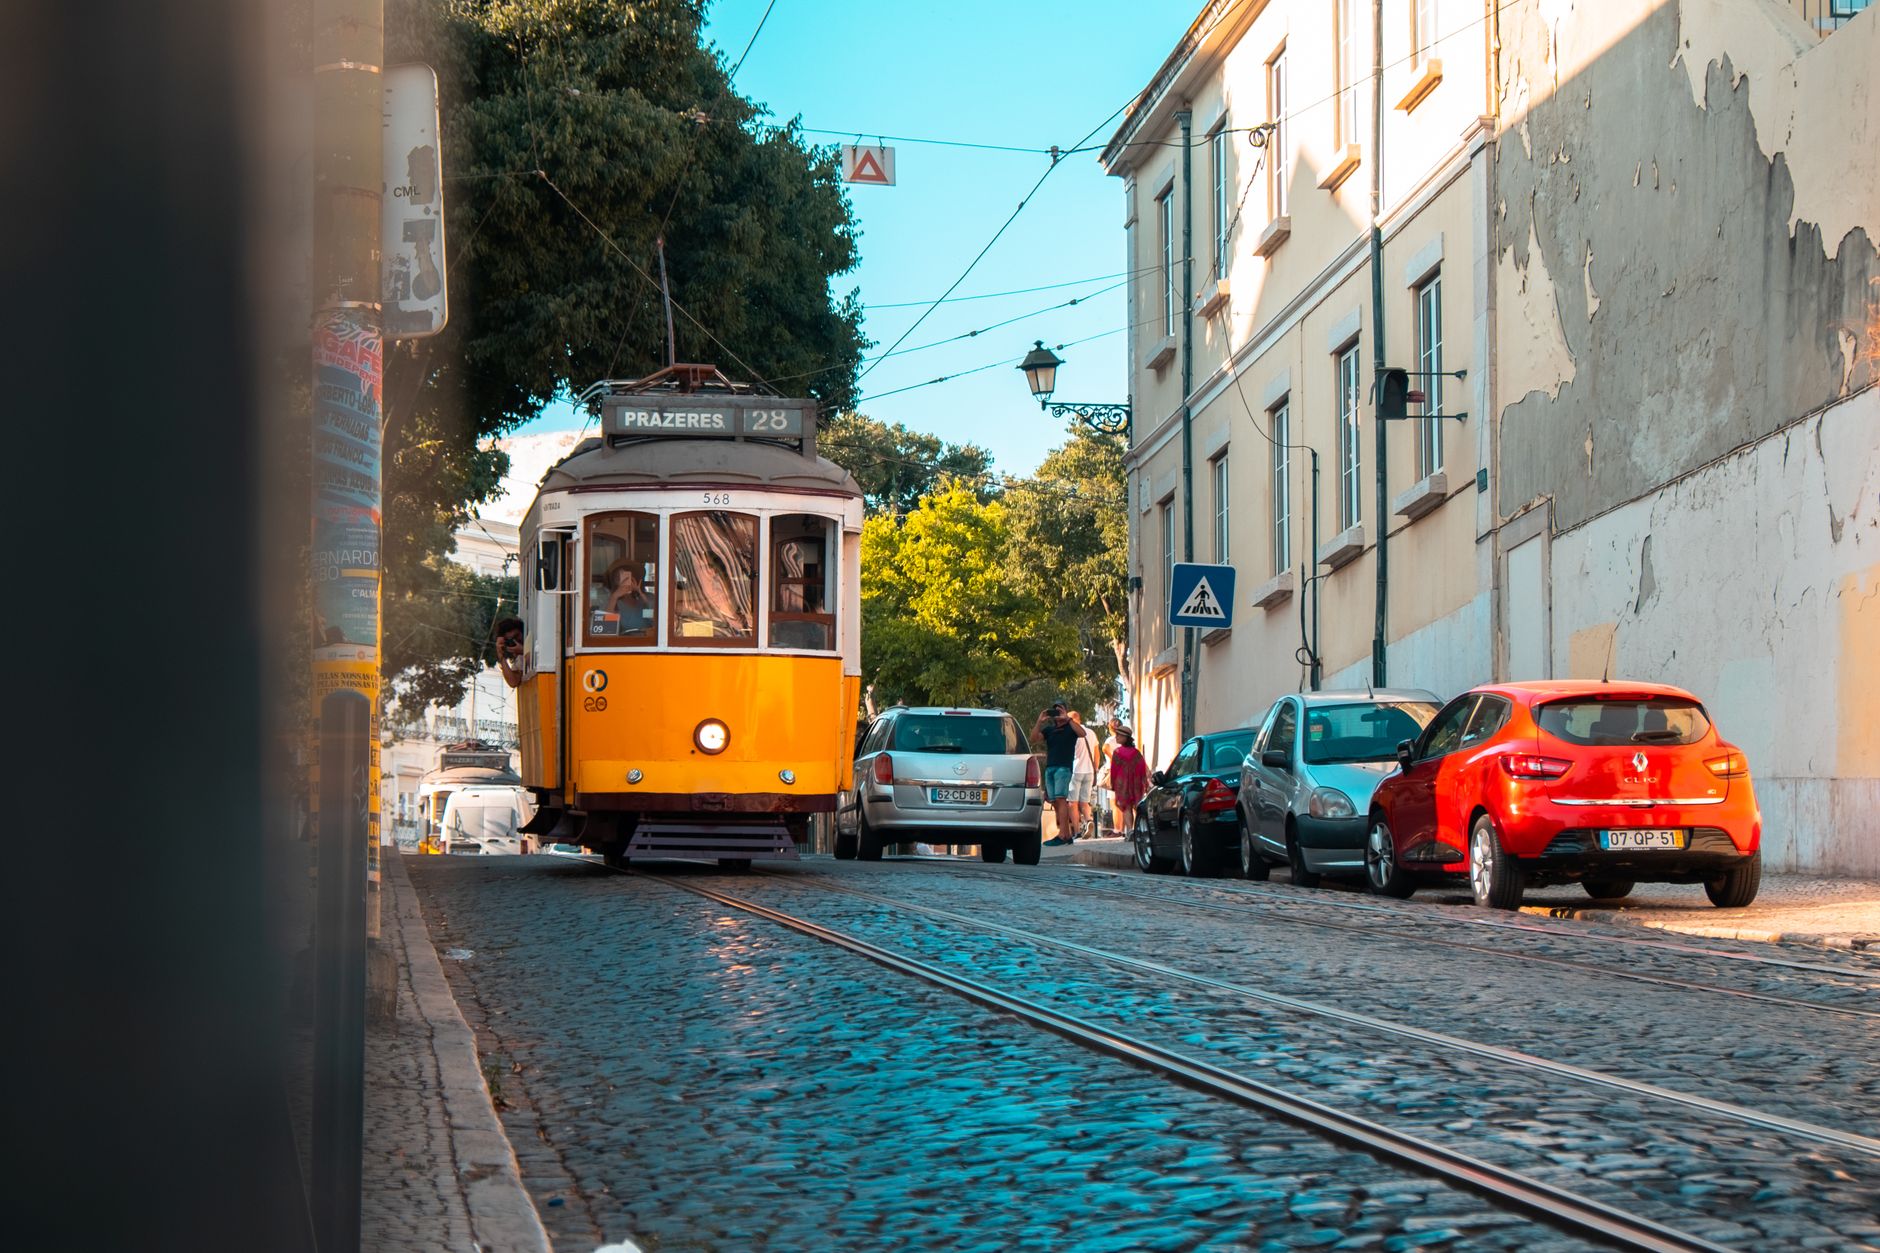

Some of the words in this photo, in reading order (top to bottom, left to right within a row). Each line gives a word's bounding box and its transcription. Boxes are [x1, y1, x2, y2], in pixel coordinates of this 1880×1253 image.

[393, 186, 421, 198] CML
[625, 411, 725, 429] PRAZERES
[752, 410, 788, 431] 28
[703, 493, 730, 505] 568
[593, 625, 604, 633] 09
